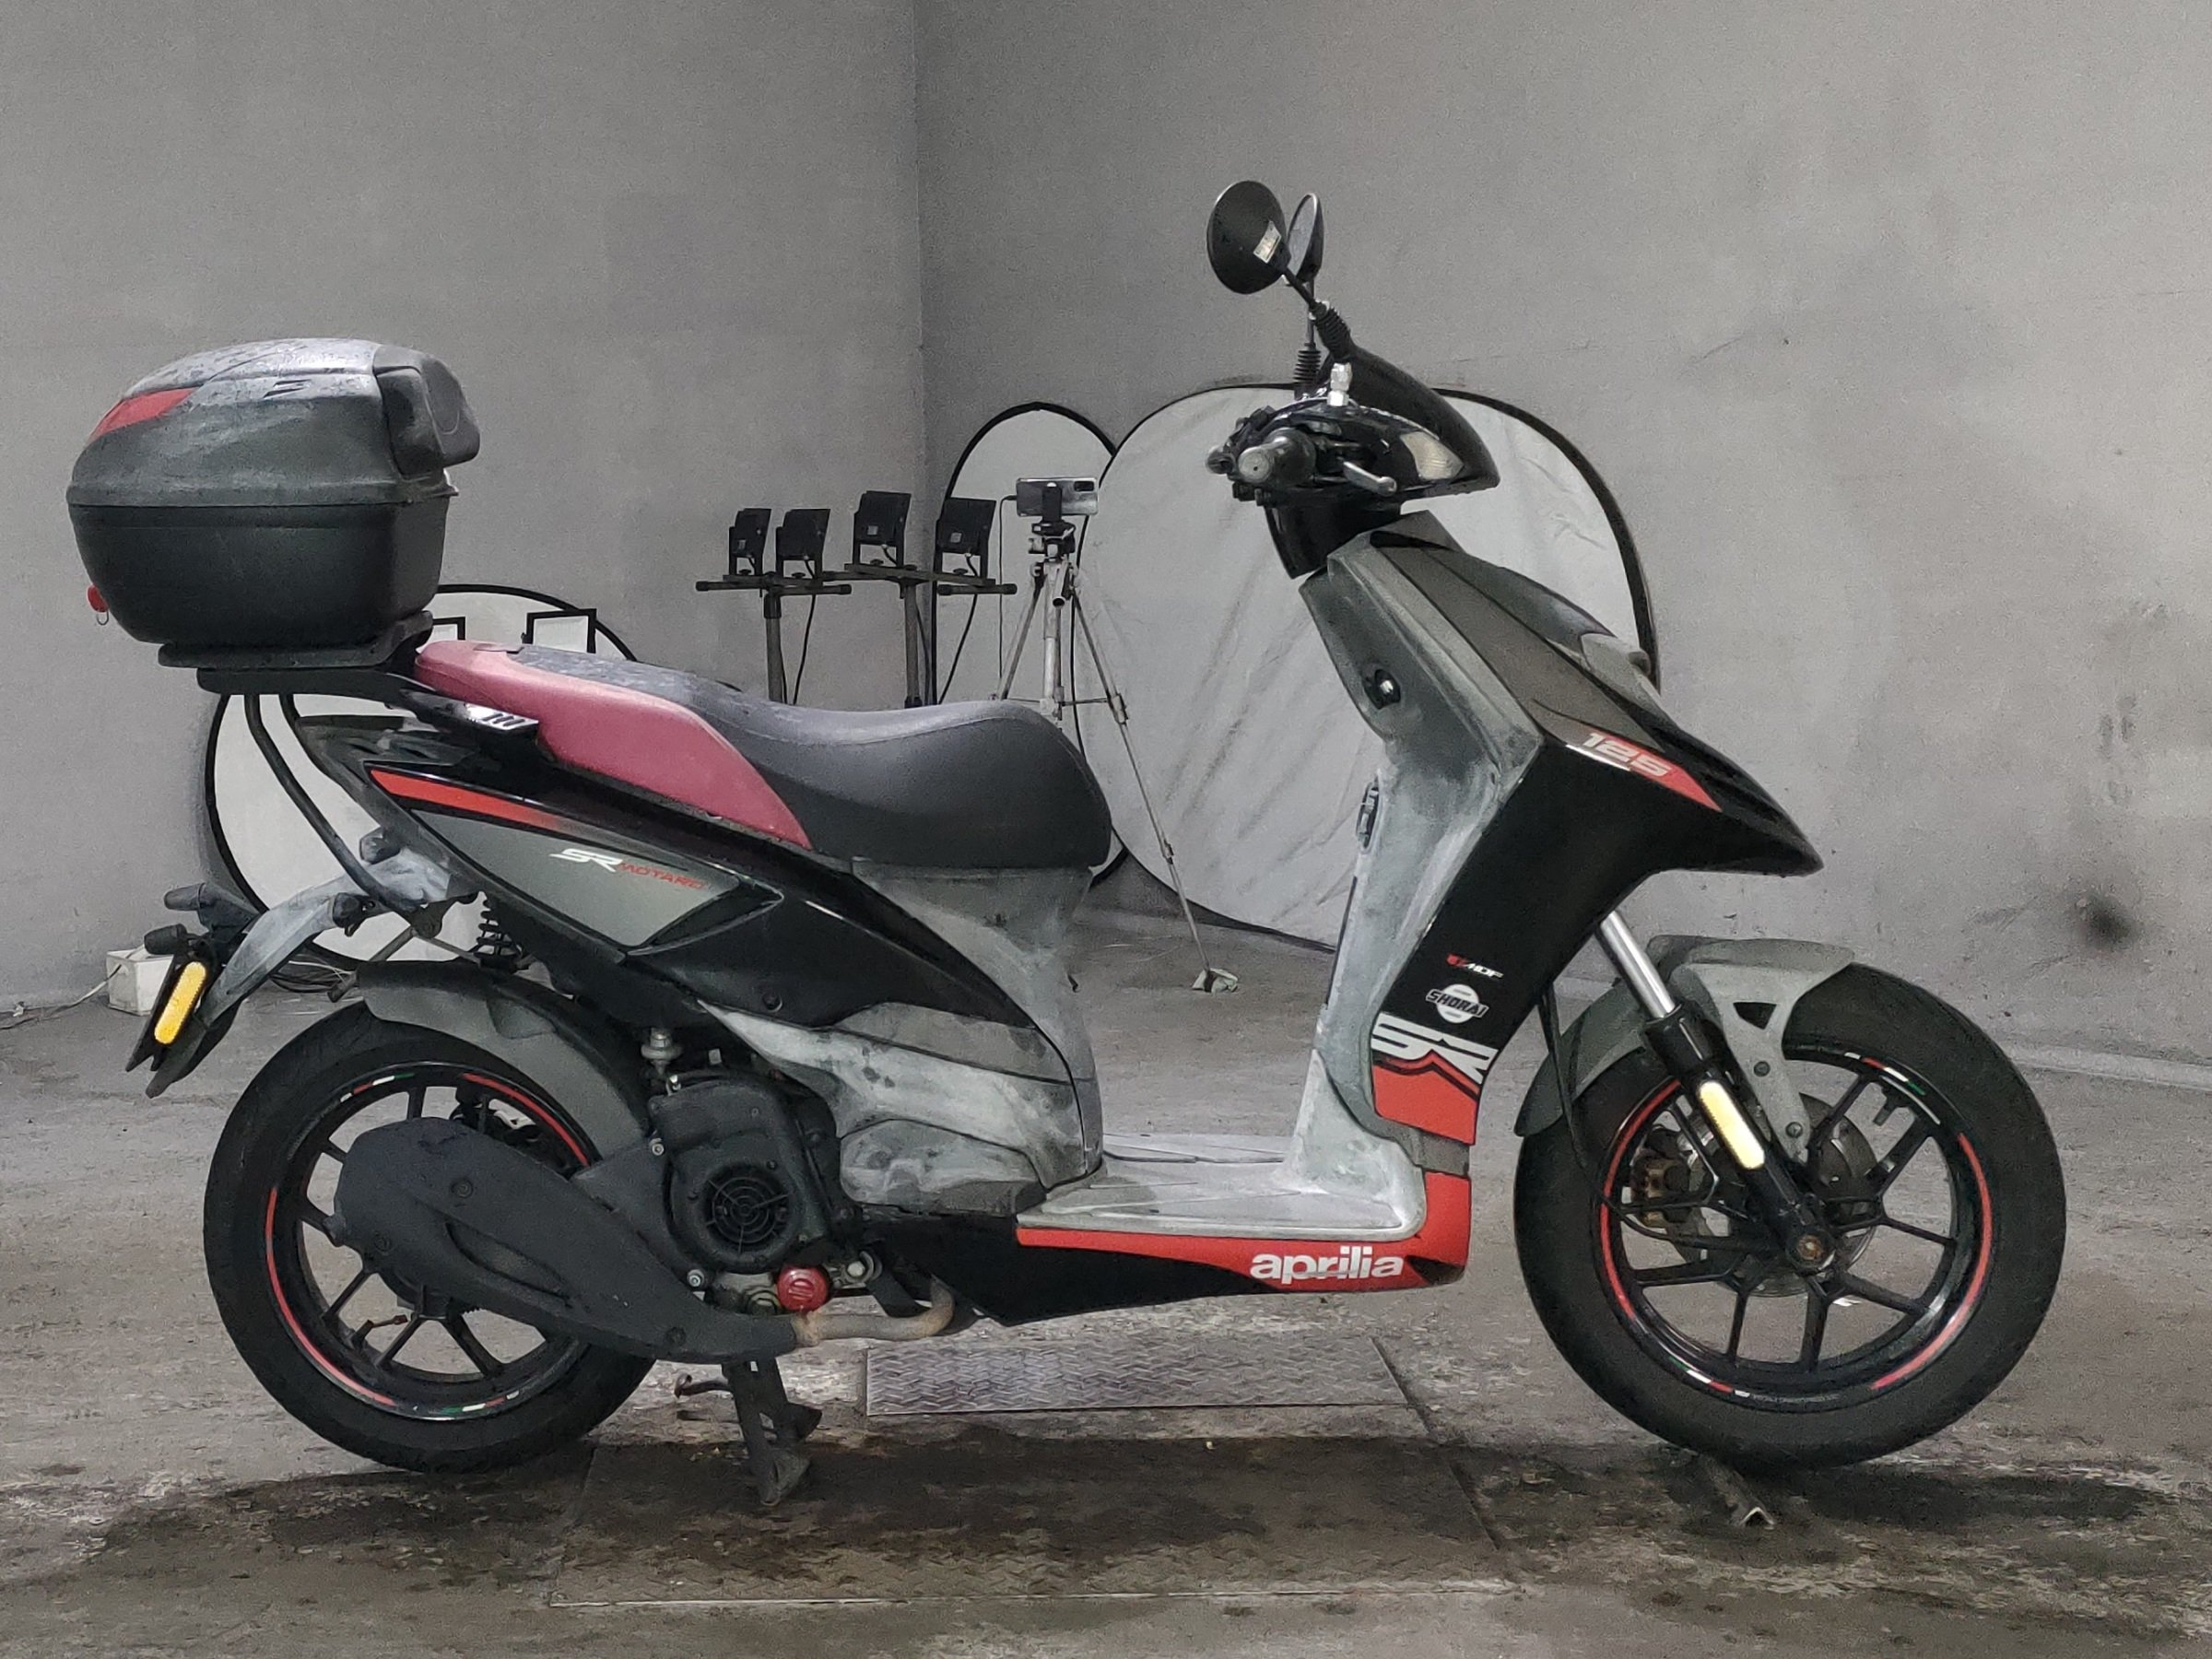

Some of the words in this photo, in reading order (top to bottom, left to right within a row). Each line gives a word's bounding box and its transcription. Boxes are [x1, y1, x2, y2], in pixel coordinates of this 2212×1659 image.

[1583, 733, 1672, 777] 125
[549, 848, 623, 873] SR
[1426, 989, 1489, 1018] SHORAI
[1250, 1246, 1404, 1284] aprilia
